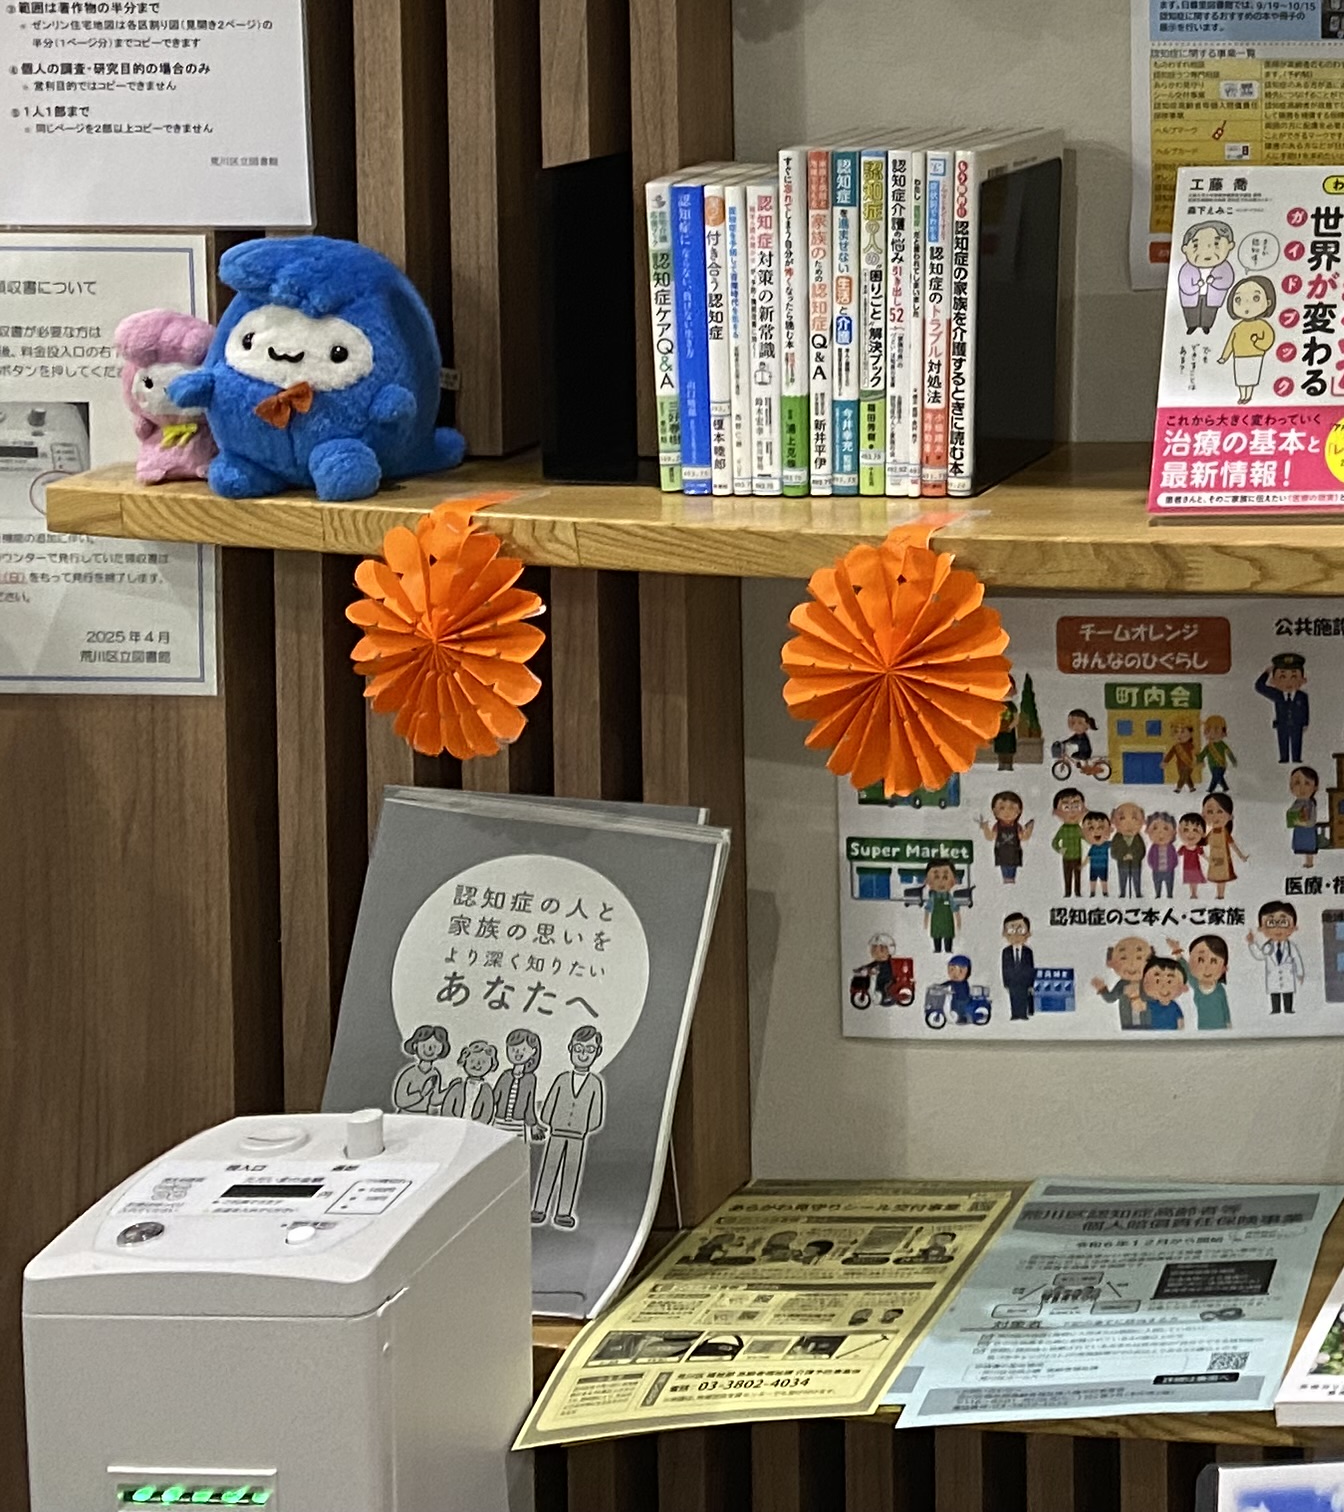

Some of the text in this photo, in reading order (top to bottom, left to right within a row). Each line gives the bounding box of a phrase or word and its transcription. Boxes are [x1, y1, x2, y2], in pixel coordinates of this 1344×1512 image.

[18, 2, 160, 14] 範囲は著作物の半分まで
[21, 63, 210, 75] 個人の調査・研究目的の場合のみ
[755, 195, 776, 359] 認知症対策の新常識
[1273, 206, 1308, 396] ガイドブック
[1300, 207, 1344, 397] 世界が変わる
[1166, 414, 1321, 427] これから大きく変わっていく
[1163, 430, 1320, 456] 治療の基本と
[1160, 462, 1291, 489] 最新情報！
[1079, 622, 1200, 643] チームオレンジ
[80, 651, 171, 664] 荒川区立図書館
[1071, 652, 1209, 672] みんなのひぐらし
[1116, 686, 1192, 706] 町内会
[849, 842, 971, 861] Super Market
[453, 885, 614, 922] 認知症の人と
[1049, 907, 1246, 928] 認知症のご本人・ご家族
[448, 915, 611, 952] 家族の思いを
[445, 947, 606, 977] より深く知りたい
[436, 971, 599, 1018] あなたへ
